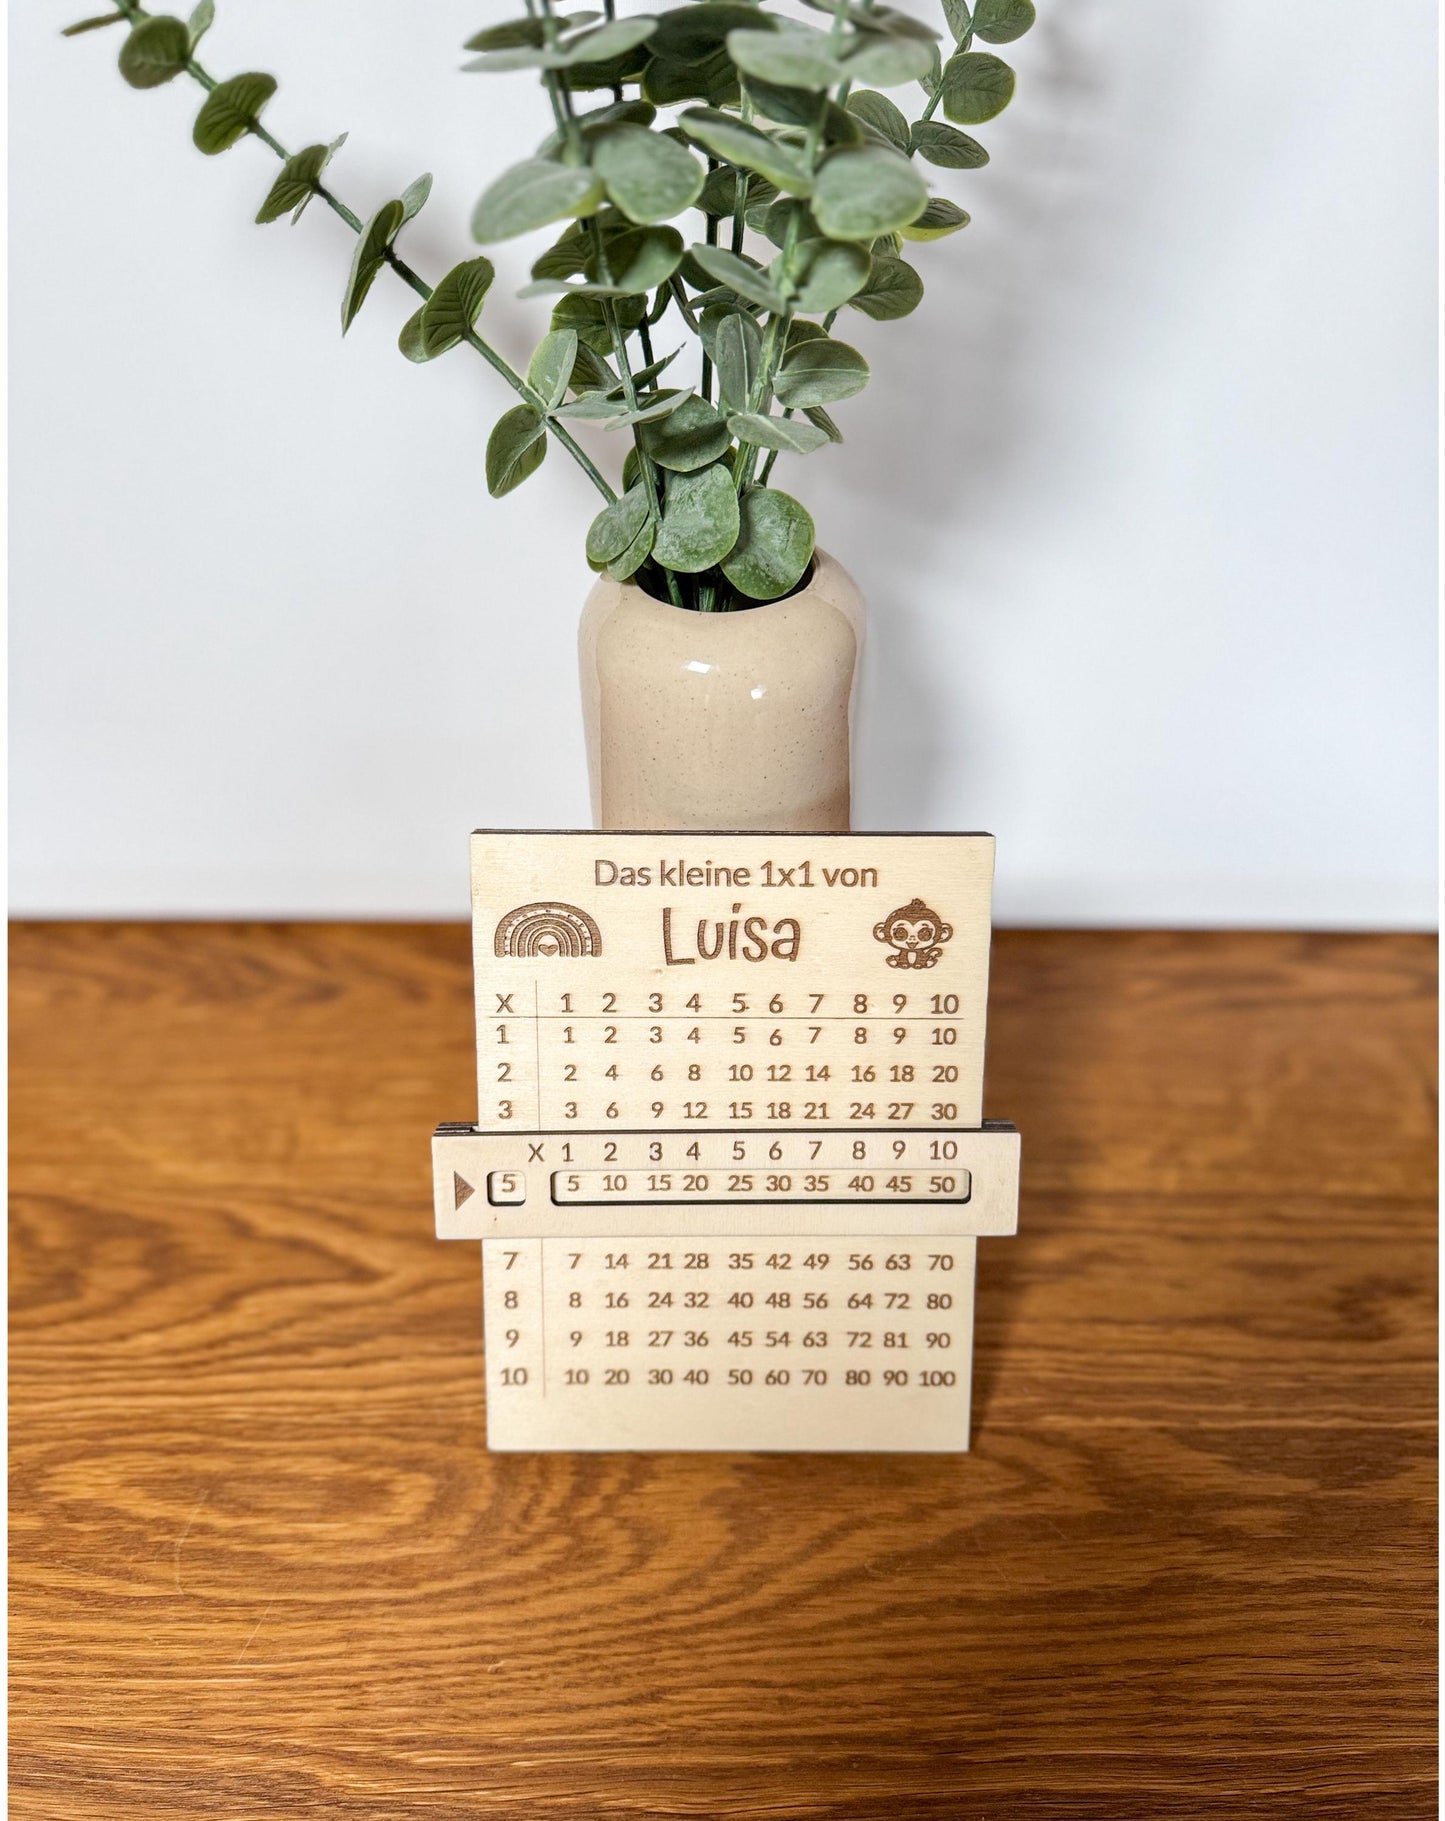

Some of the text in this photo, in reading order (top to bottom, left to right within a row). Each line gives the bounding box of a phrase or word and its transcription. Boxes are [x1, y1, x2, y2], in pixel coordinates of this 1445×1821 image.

[594, 859, 878, 888] Das kleine 1x1 von
[662, 902, 802, 966] Luisa
[560, 992, 574, 1013] 1
[601, 992, 618, 1014] 2
[648, 992, 664, 1014] 3
[685, 992, 703, 1013] 4
[731, 992, 747, 1014] 5
[768, 993, 784, 1014] 6
[808, 993, 825, 1014] 7
[853, 993, 868, 1015] 8
[892, 993, 908, 1014] 9
[930, 993, 960, 1015] 10
[495, 1024, 957, 1047] 1 1 2 3 4 5 6 7 8 9 10
[497, 1062, 959, 1083] 2 2 4 6 8 10 12 14 16 18 20
[497, 1099, 958, 1121] 3 3 6 9 12 15 18 21 24 27 30
[561, 1142, 574, 1163] 1
[603, 1141, 618, 1162] 2
[648, 1141, 664, 1162] 3
[685, 1141, 701, 1161] 4
[732, 1140, 746, 1161] 5
[768, 1140, 783, 1161] 6
[808, 1140, 823, 1161] 7
[852, 1140, 867, 1161] 8
[892, 1140, 906, 1160] 9
[929, 1140, 958, 1161] 10
[501, 1173, 956, 1194] 5 5 10 15 20 25 30 35 40 45 50
[502, 1251, 954, 1272] 7 7 14 21 28 35 42 49 56 63 70
[503, 1290, 953, 1311] 8 8 16 24 32 40 48 56 64 72 80
[505, 1328, 952, 1349] 9 9 18 27 36 45 54 63 72 81 90
[500, 1367, 957, 1388] 10 10 20 30 40 50 60 70 80 90 100
